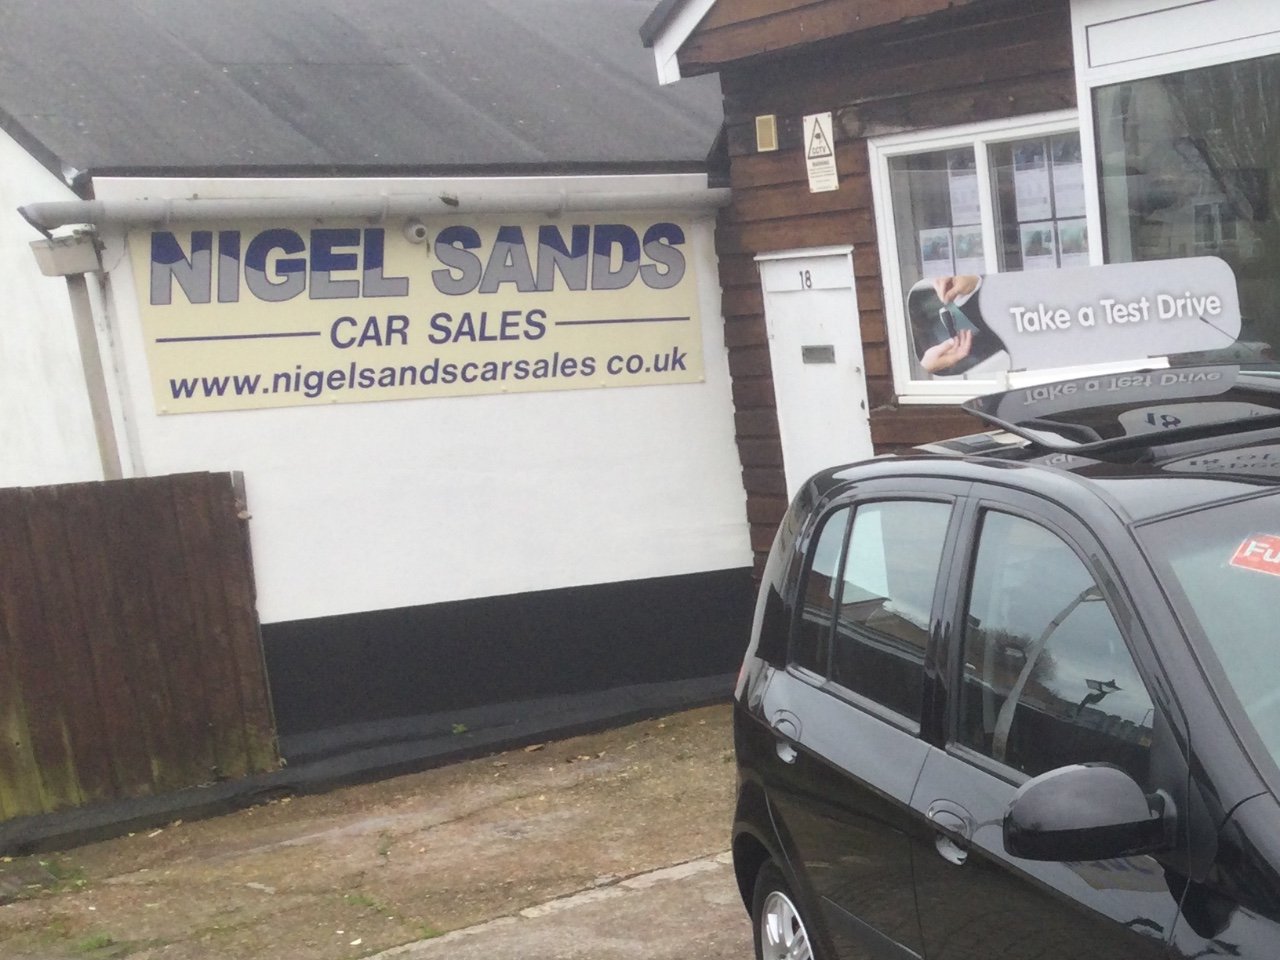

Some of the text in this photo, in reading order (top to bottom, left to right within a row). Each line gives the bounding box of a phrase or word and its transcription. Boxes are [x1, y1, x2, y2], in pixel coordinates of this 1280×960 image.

[150, 222, 687, 306] NIGEL SANDS
[799, 269, 812, 289] 18
[329, 309, 548, 349] CAR SALES
[1009, 292, 1223, 334] Take a Test Drive
